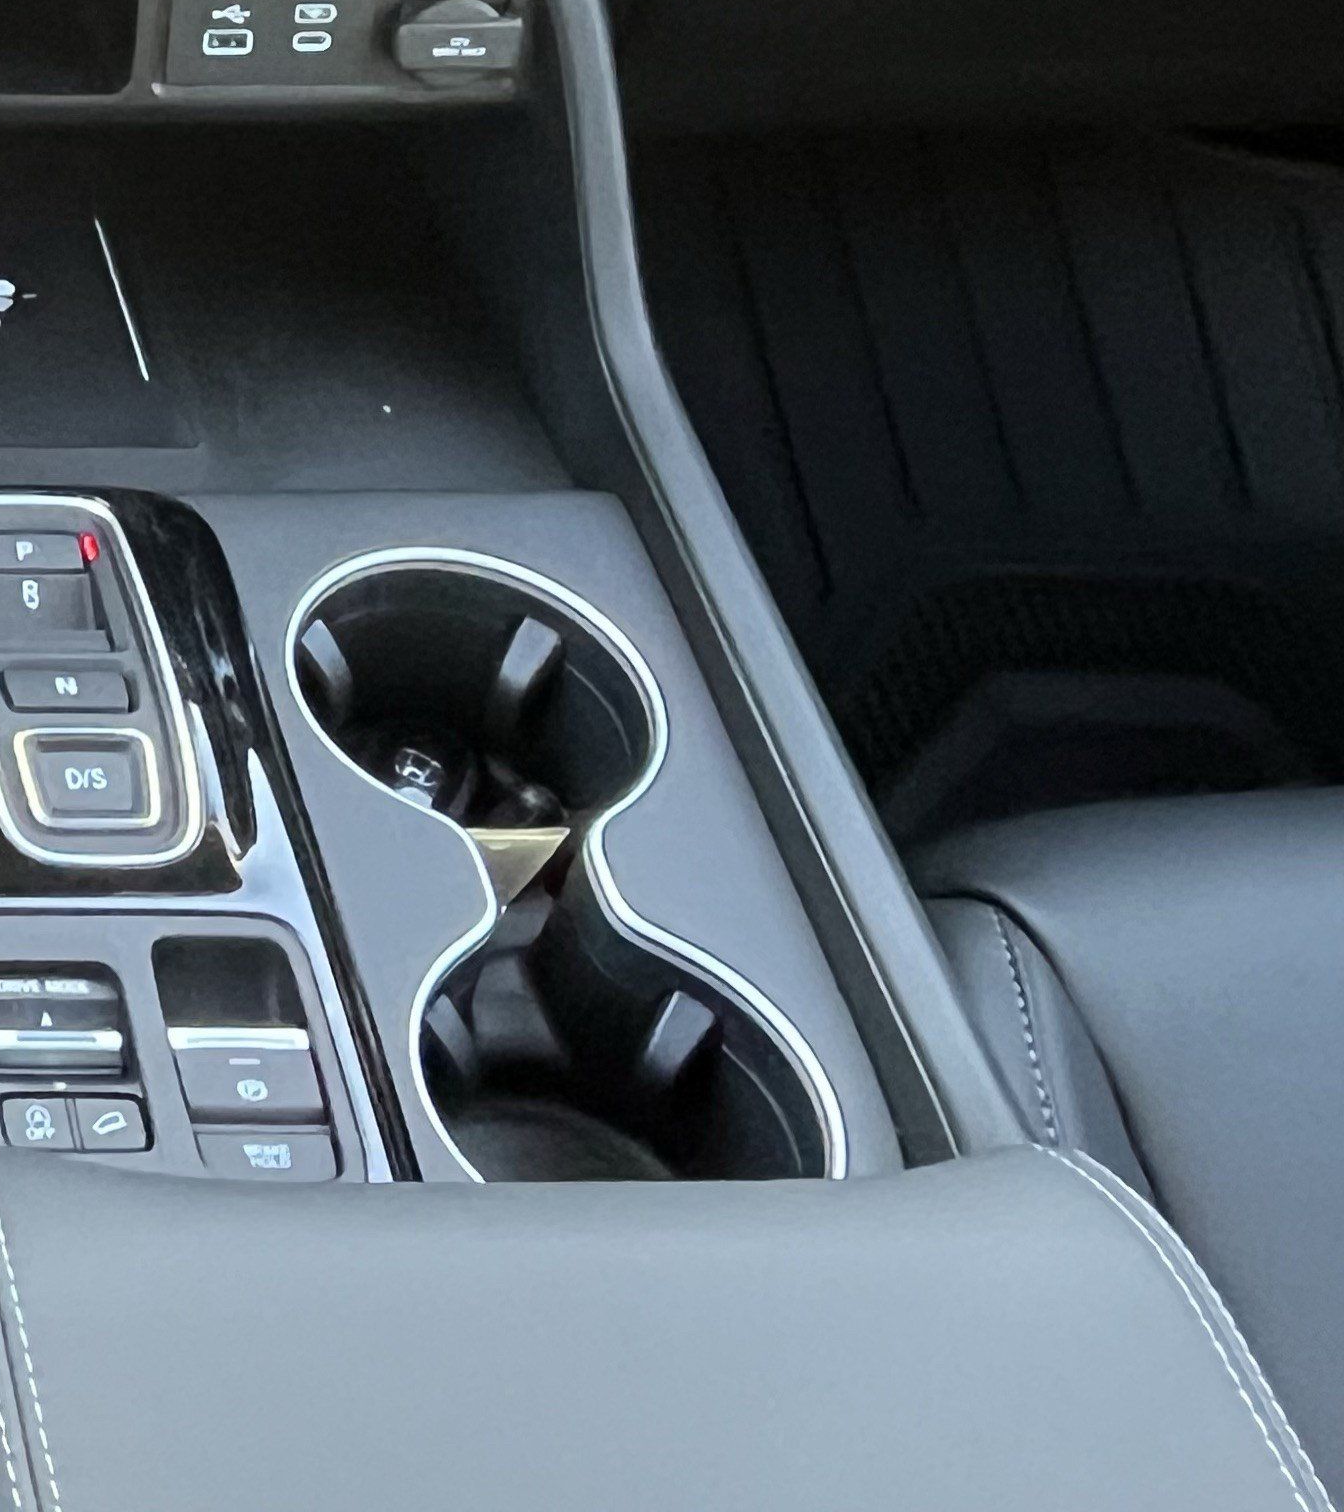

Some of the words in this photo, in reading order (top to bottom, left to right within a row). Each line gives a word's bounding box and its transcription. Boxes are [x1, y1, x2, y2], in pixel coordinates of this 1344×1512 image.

[15, 541, 34, 562] P
[54, 675, 78, 696] N
[64, 766, 109, 791] D/S
